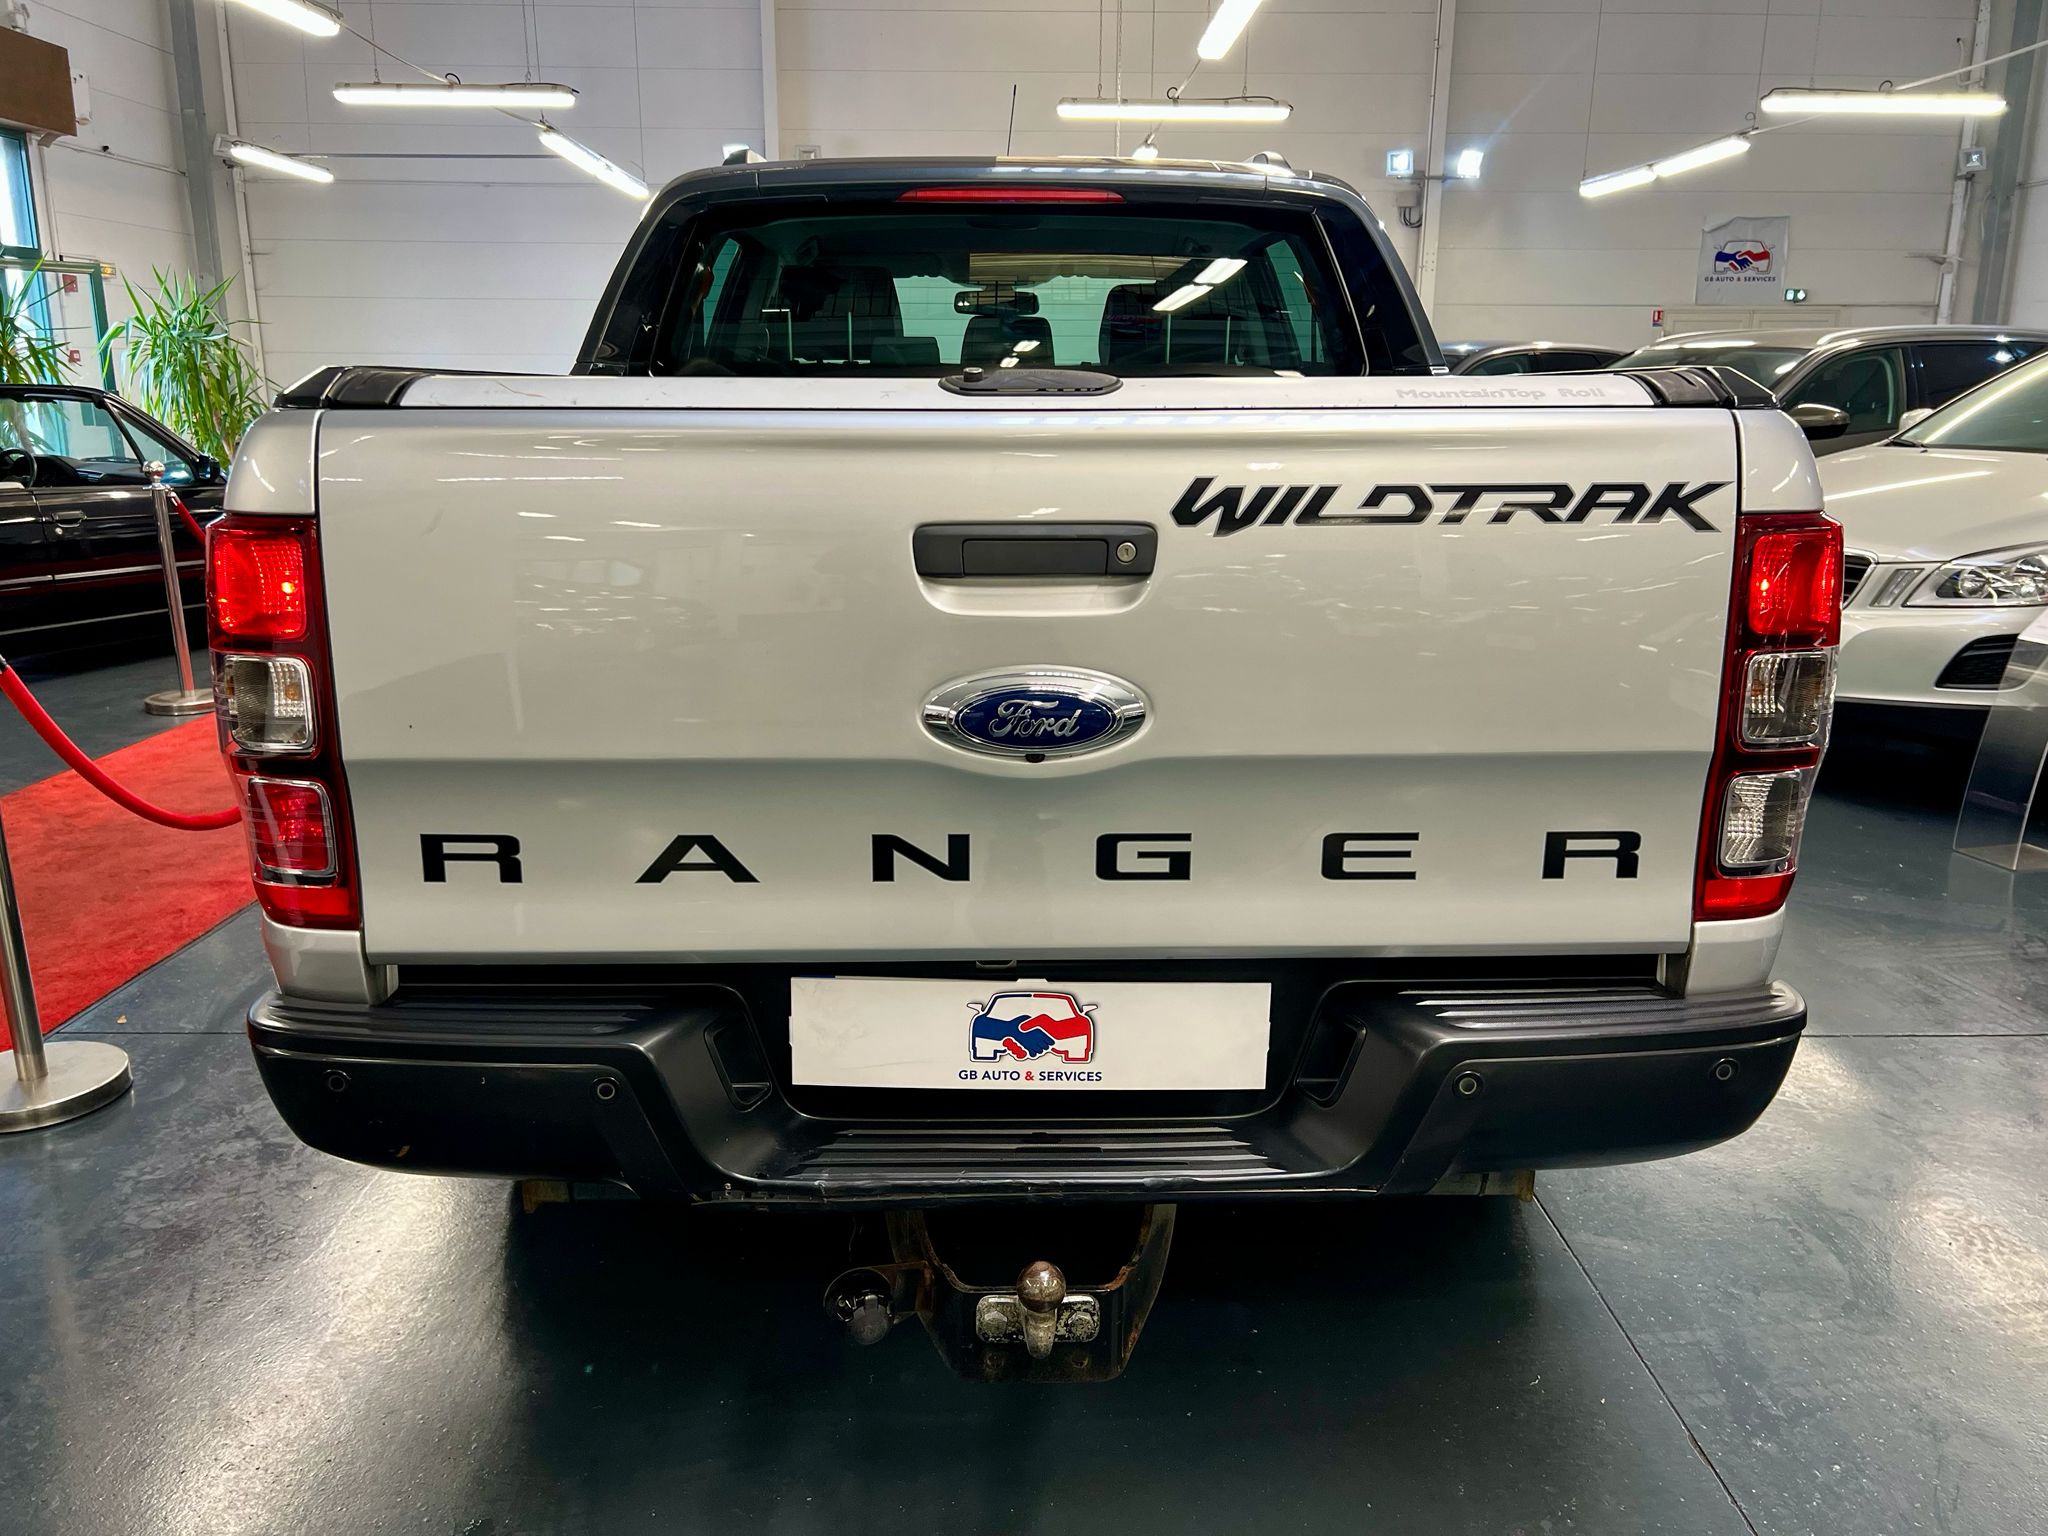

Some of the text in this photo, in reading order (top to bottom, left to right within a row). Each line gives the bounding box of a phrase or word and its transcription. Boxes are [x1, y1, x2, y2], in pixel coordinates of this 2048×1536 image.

[1396, 387, 1606, 400] MountainTop Roll
[1170, 475, 1734, 538] WILDTRAK
[989, 699, 1081, 738] Ford
[419, 830, 1642, 885] RANGER
[958, 1069, 1103, 1082] GB AUTO & SERVICES
